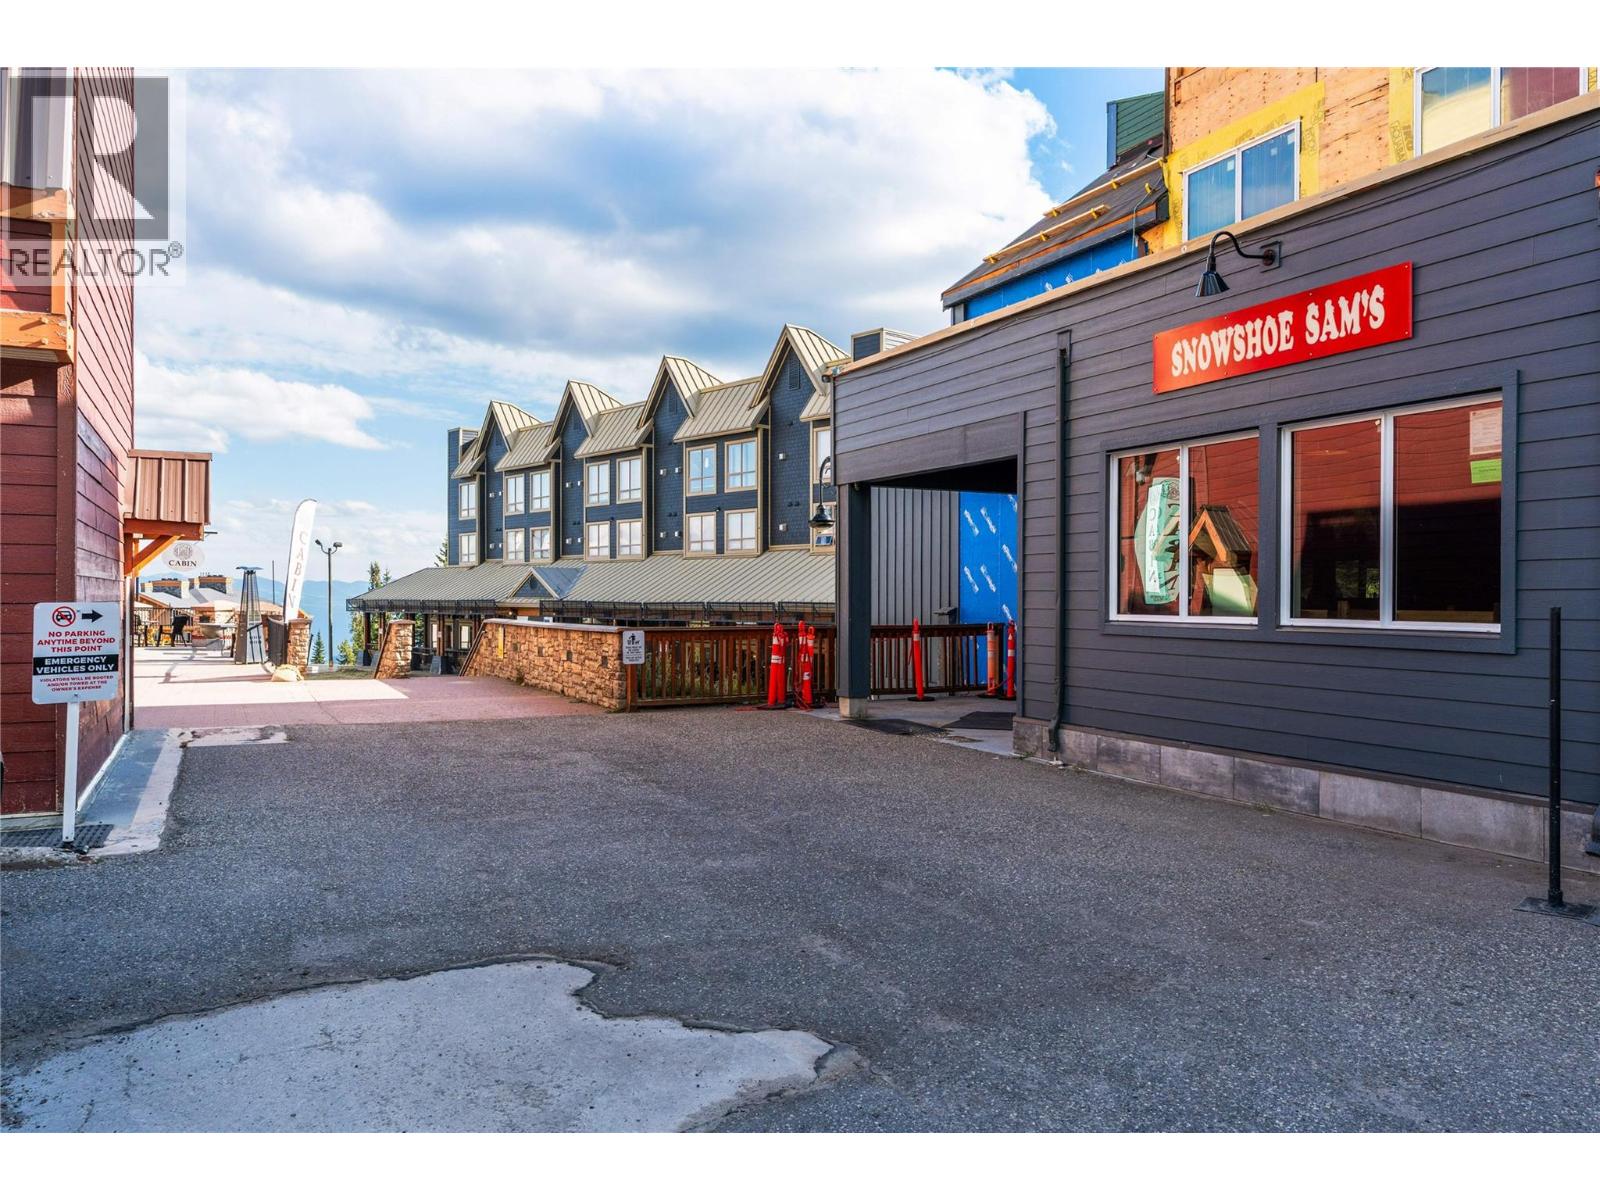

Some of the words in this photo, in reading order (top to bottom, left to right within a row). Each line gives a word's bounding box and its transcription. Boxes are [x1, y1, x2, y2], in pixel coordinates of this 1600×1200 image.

[1171, 310, 1294, 377] SNOWSHOE
[1305, 284, 1385, 345] SAM'S
[168, 559, 197, 567] CABIN
[37, 638, 77, 646] ANYTIME
[44, 656, 107, 665] EMERGENCY
[36, 665, 86, 674] VEHICLES
[88, 664, 115, 672] ONLY
